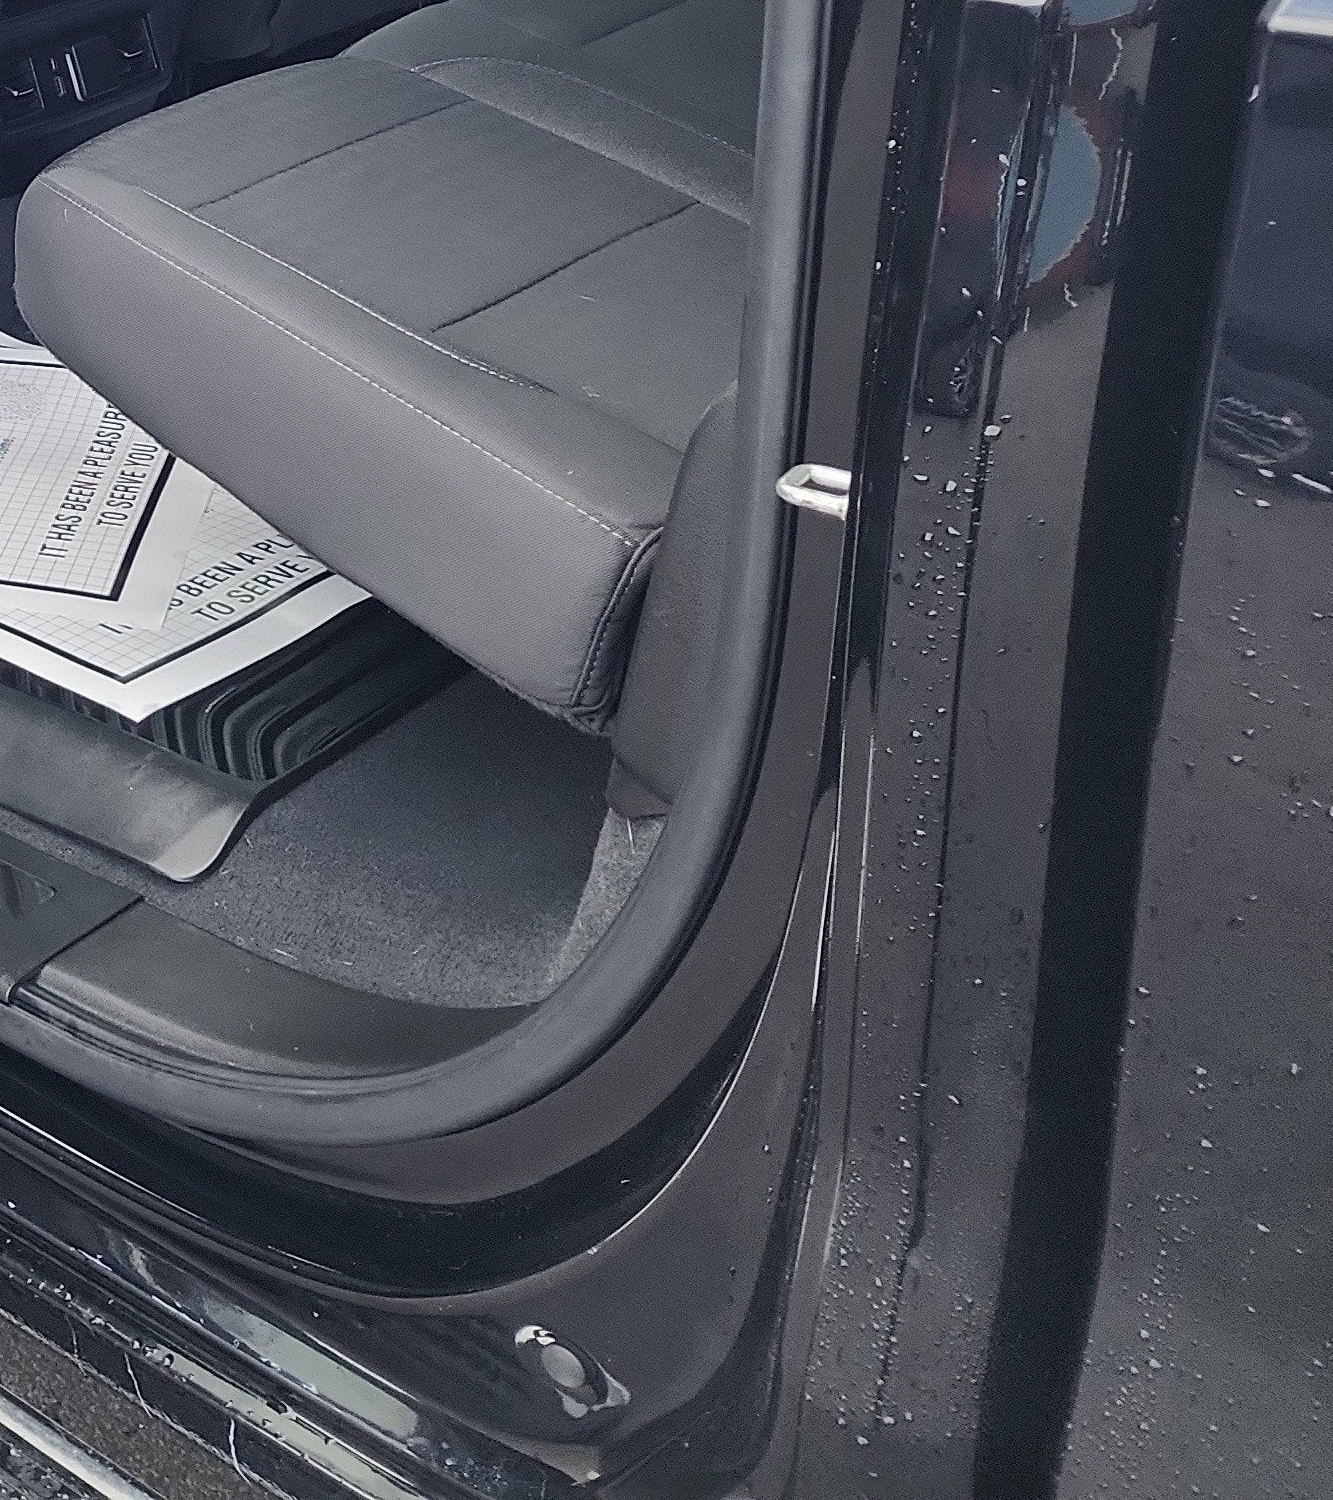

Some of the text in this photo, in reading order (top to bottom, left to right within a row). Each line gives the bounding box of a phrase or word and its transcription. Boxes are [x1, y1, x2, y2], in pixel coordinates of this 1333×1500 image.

[77, 470, 105, 480] A
[96, 443, 160, 527] TO SERVE YOU
[59, 479, 100, 512] BEEN
[46, 513, 83, 541] HAS
[38, 543, 69, 558] IT
[176, 561, 245, 597] BEEN
[235, 551, 264, 566] A
[190, 559, 311, 622] TO SERVE
